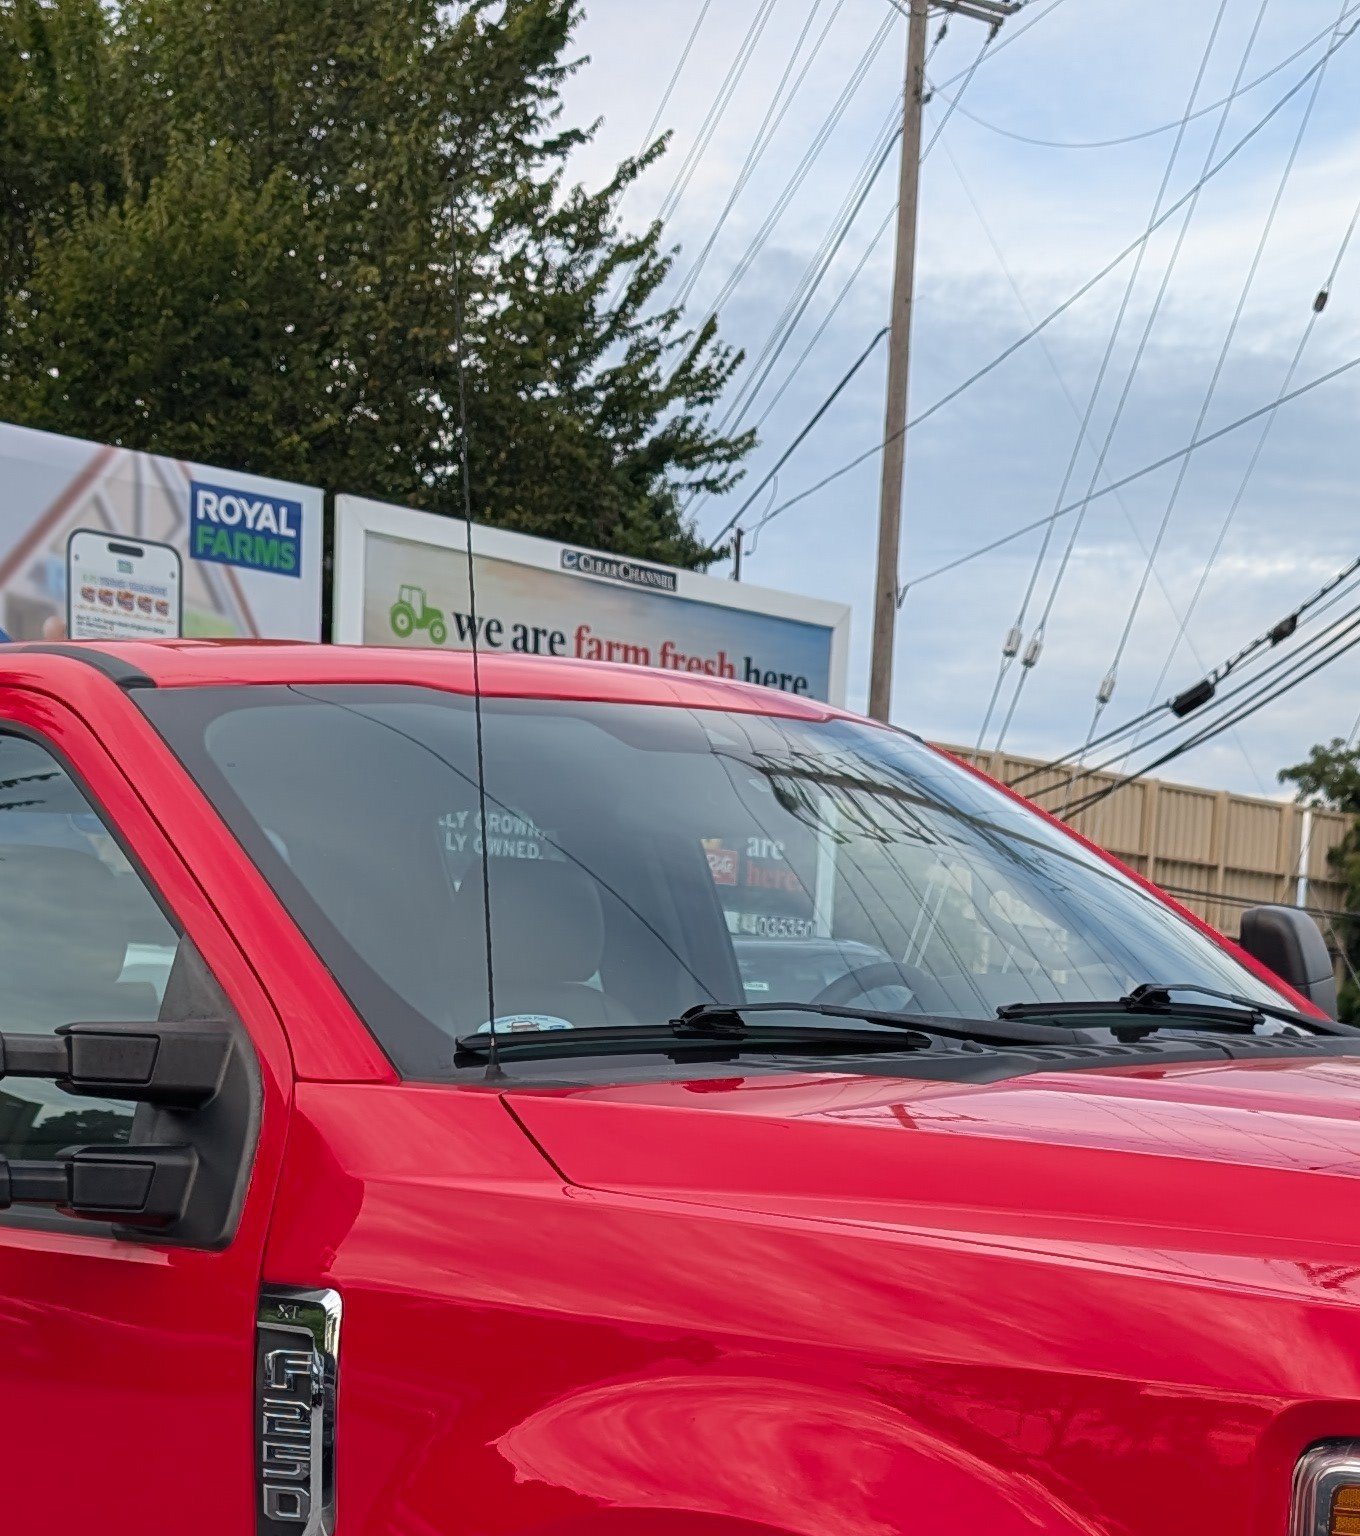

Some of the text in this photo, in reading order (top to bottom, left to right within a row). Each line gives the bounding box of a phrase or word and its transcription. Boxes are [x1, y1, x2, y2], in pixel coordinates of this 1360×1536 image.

[196, 489, 297, 539] ROYAL
[196, 525, 297, 571] FARMS
[452, 611, 503, 648] we
[511, 622, 566, 657] are
[574, 624, 651, 665] farm
[659, 640, 736, 679] fresh
[745, 836, 785, 861] are
